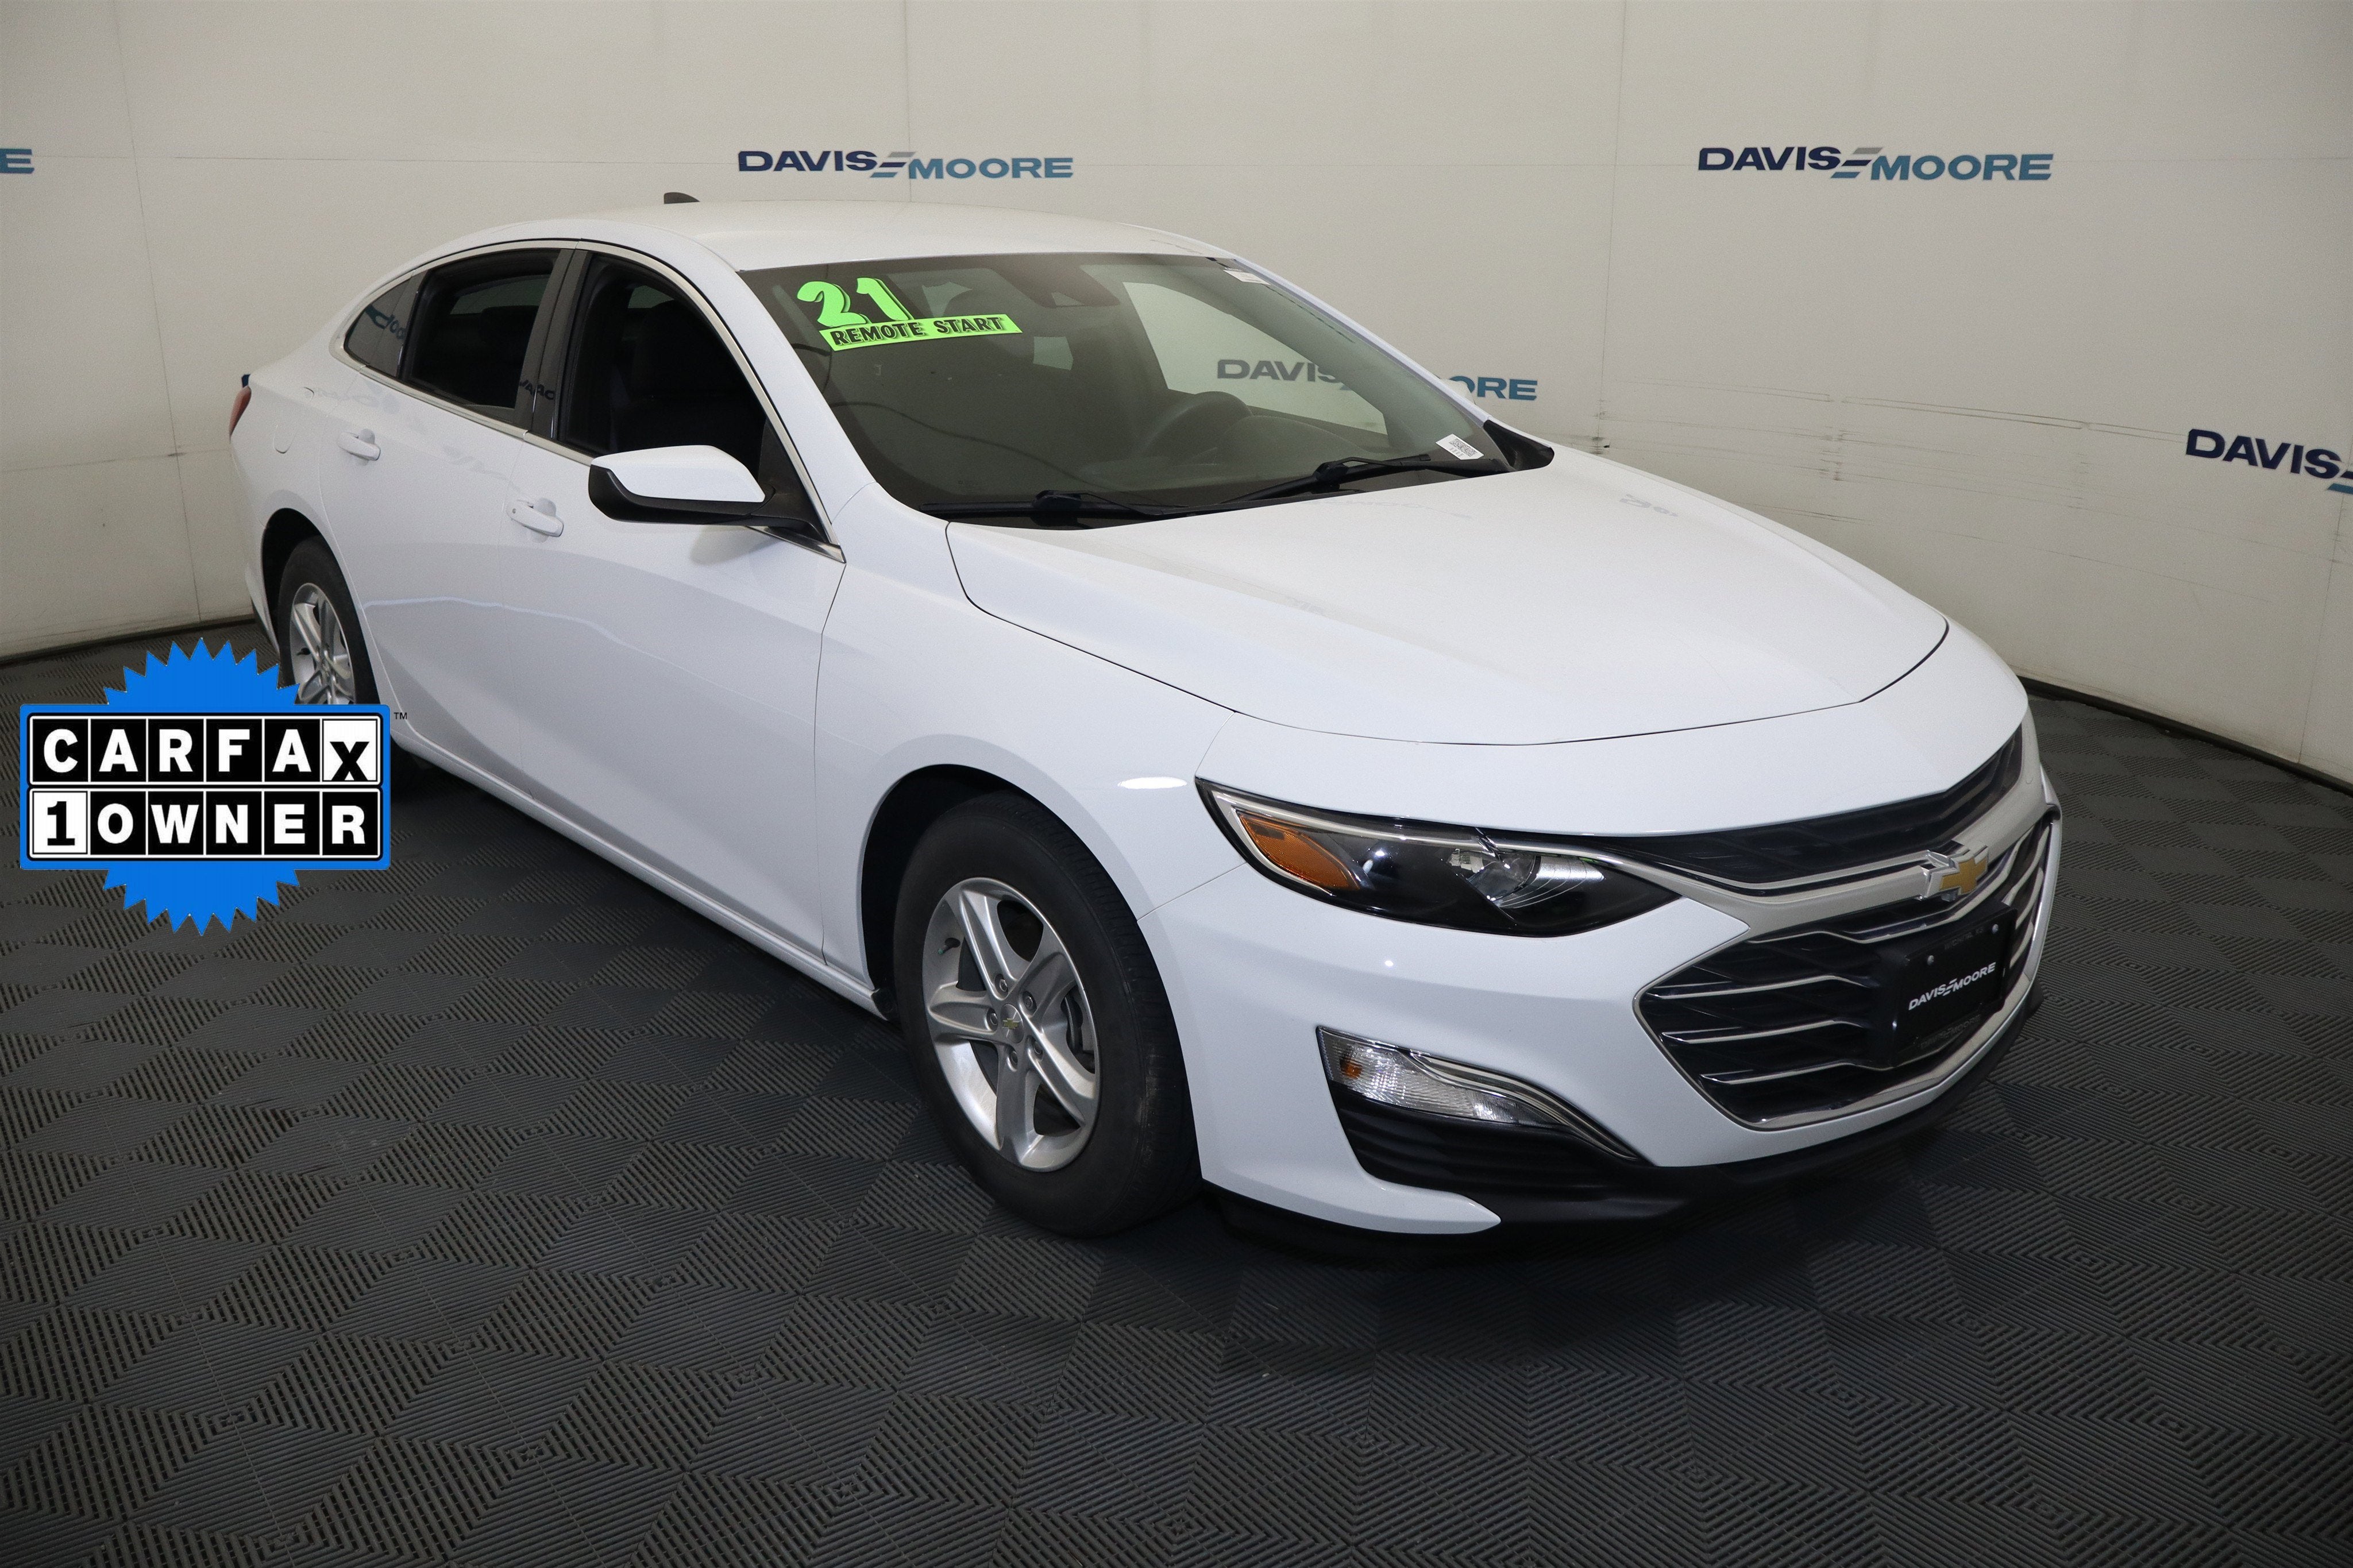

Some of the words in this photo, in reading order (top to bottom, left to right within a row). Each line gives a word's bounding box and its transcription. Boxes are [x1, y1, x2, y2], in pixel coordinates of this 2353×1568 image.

[738, 151, 878, 171] DAVIS
[909, 158, 1074, 179] MOORE
[1698, 146, 1842, 171] DAVIS
[1870, 154, 2054, 180] MOORE
[797, 277, 913, 327] 21
[830, 322, 925, 346] REMOTE
[933, 317, 1003, 334] START
[2186, 428, 2342, 479] DAVIS
[1908, 984, 1946, 1010] DAVIS
[1952, 962, 1996, 992] MOORE
